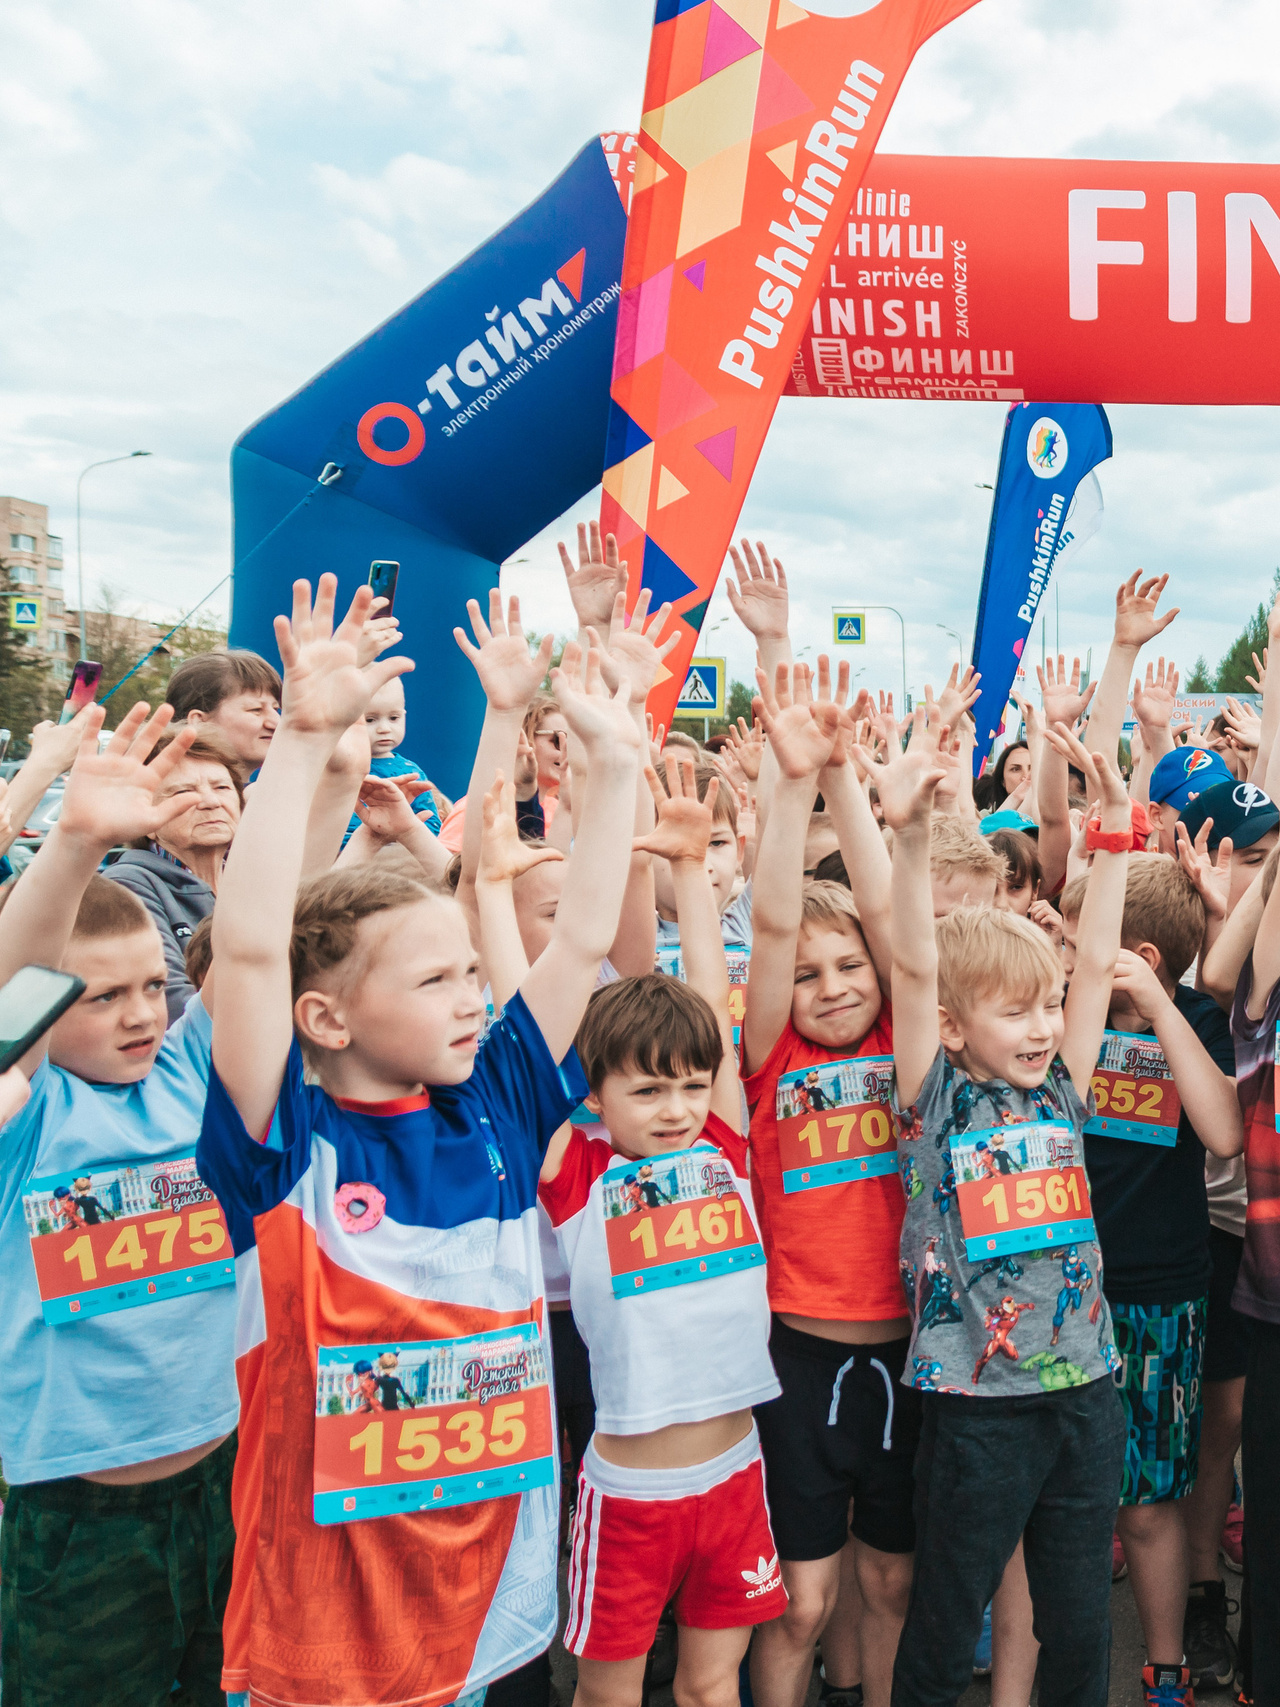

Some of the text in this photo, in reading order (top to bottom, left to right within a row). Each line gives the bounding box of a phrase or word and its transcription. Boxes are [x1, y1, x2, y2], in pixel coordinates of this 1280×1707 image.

[718, 60, 884, 389] PushkinRun
[851, 188, 911, 217] linie
[834, 222, 944, 260] НИШ
[858, 265, 944, 289] arrivée
[950, 239, 969, 339] ZAKOŃCZYĆ
[440, 281, 623, 438] электронный хронометраж
[853, 346, 1014, 376] ФИНИШ
[853, 376, 999, 388] TERMINAR
[1017, 492, 1066, 624] PushkinRun
[982, 1173, 1082, 1224] 1561
[63, 1207, 226, 1282] 1475
[629, 1199, 744, 1259] 1467
[463, 1352, 527, 1393] Детский
[479, 1381, 521, 1405] забег
[349, 1400, 527, 1476] 1535
